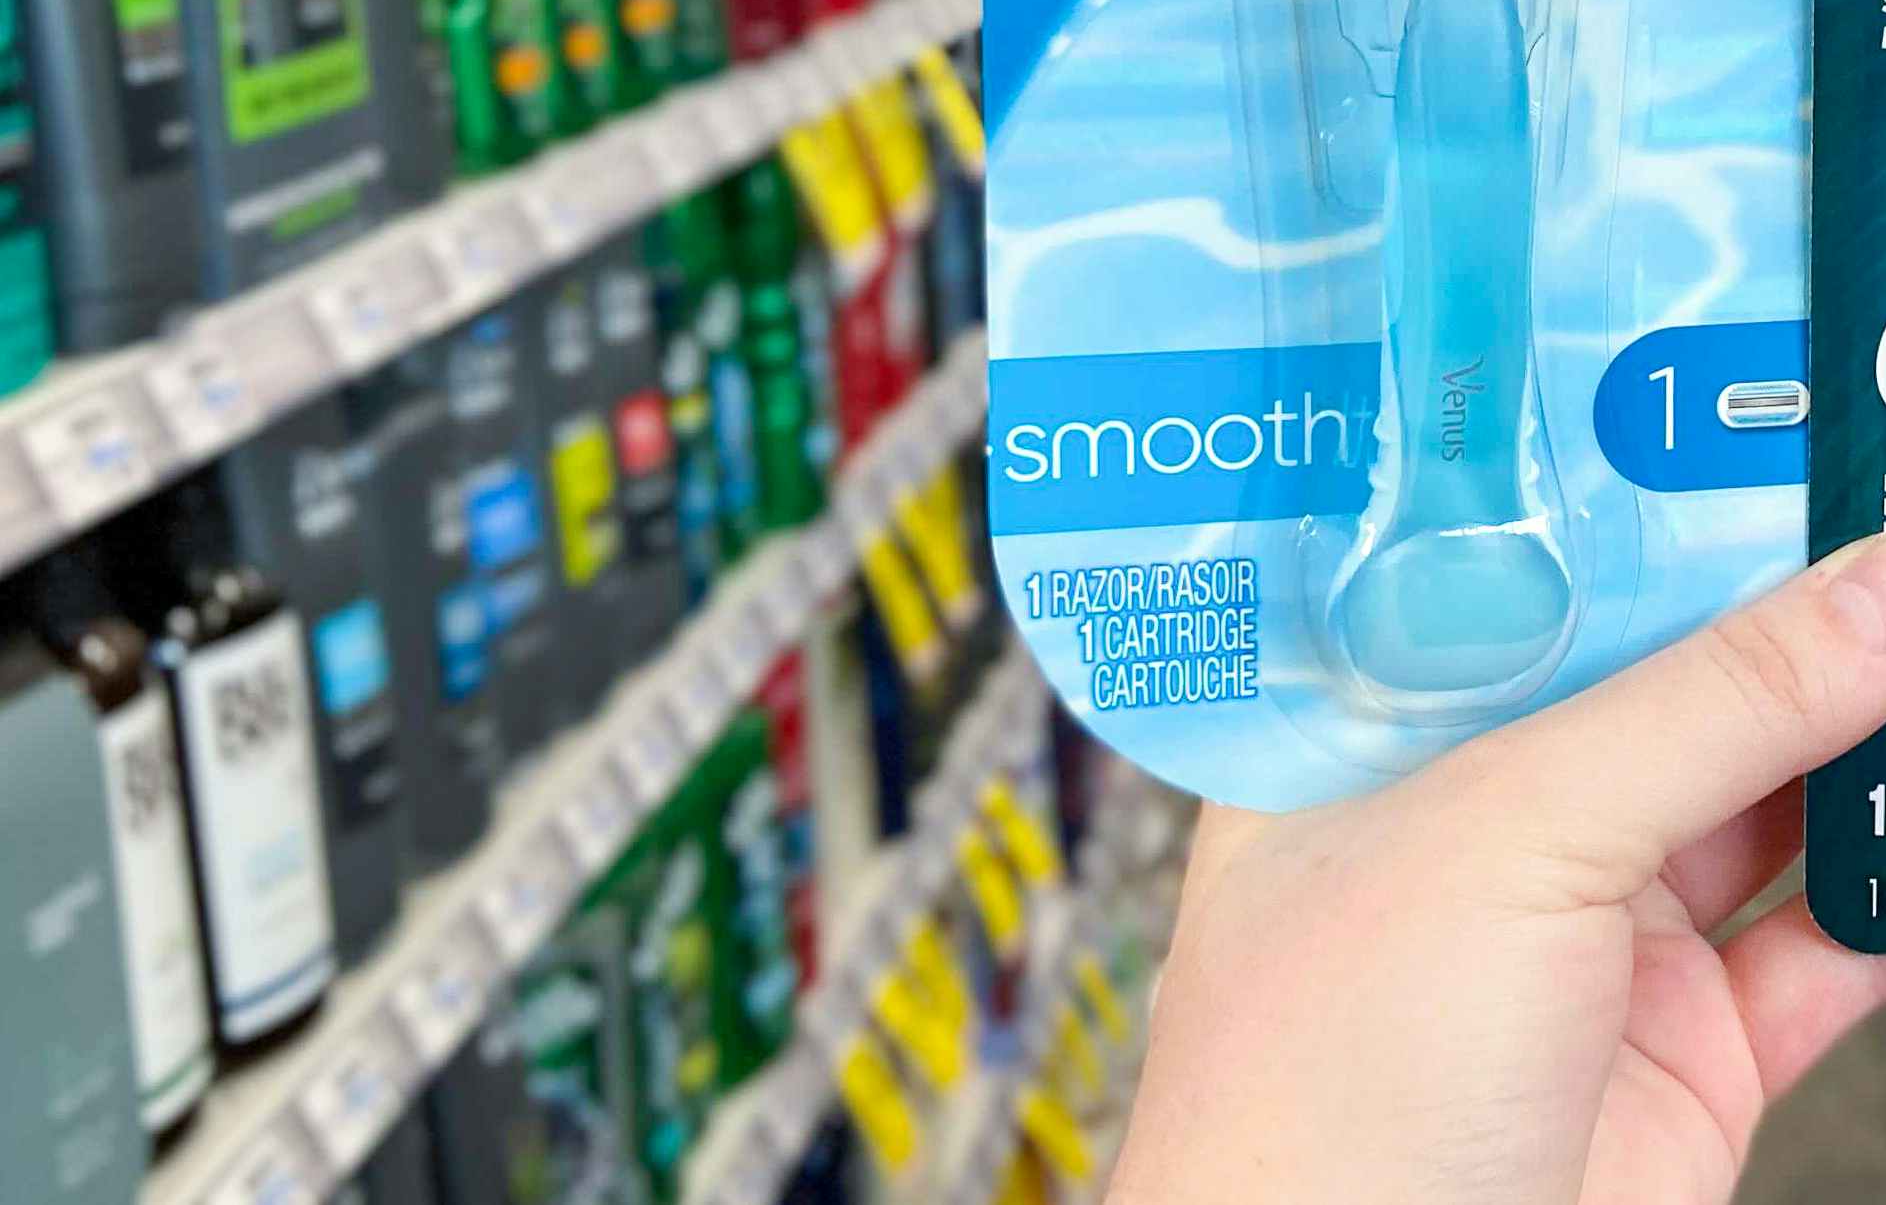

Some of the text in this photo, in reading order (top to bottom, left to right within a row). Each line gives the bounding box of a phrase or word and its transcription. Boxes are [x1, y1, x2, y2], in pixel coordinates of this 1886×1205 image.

[1440, 355, 1485, 463] Venus
[1648, 365, 1675, 450] 1
[1003, 391, 1349, 483] smooth
[1026, 560, 1256, 618] 1 RAZOR/RASOIR
[1079, 608, 1256, 663] 1 CARTRIDGE
[1094, 654, 1257, 709] CARTOUCHE
[1868, 783, 1886, 836] 1
[1868, 878, 1879, 918] 1
